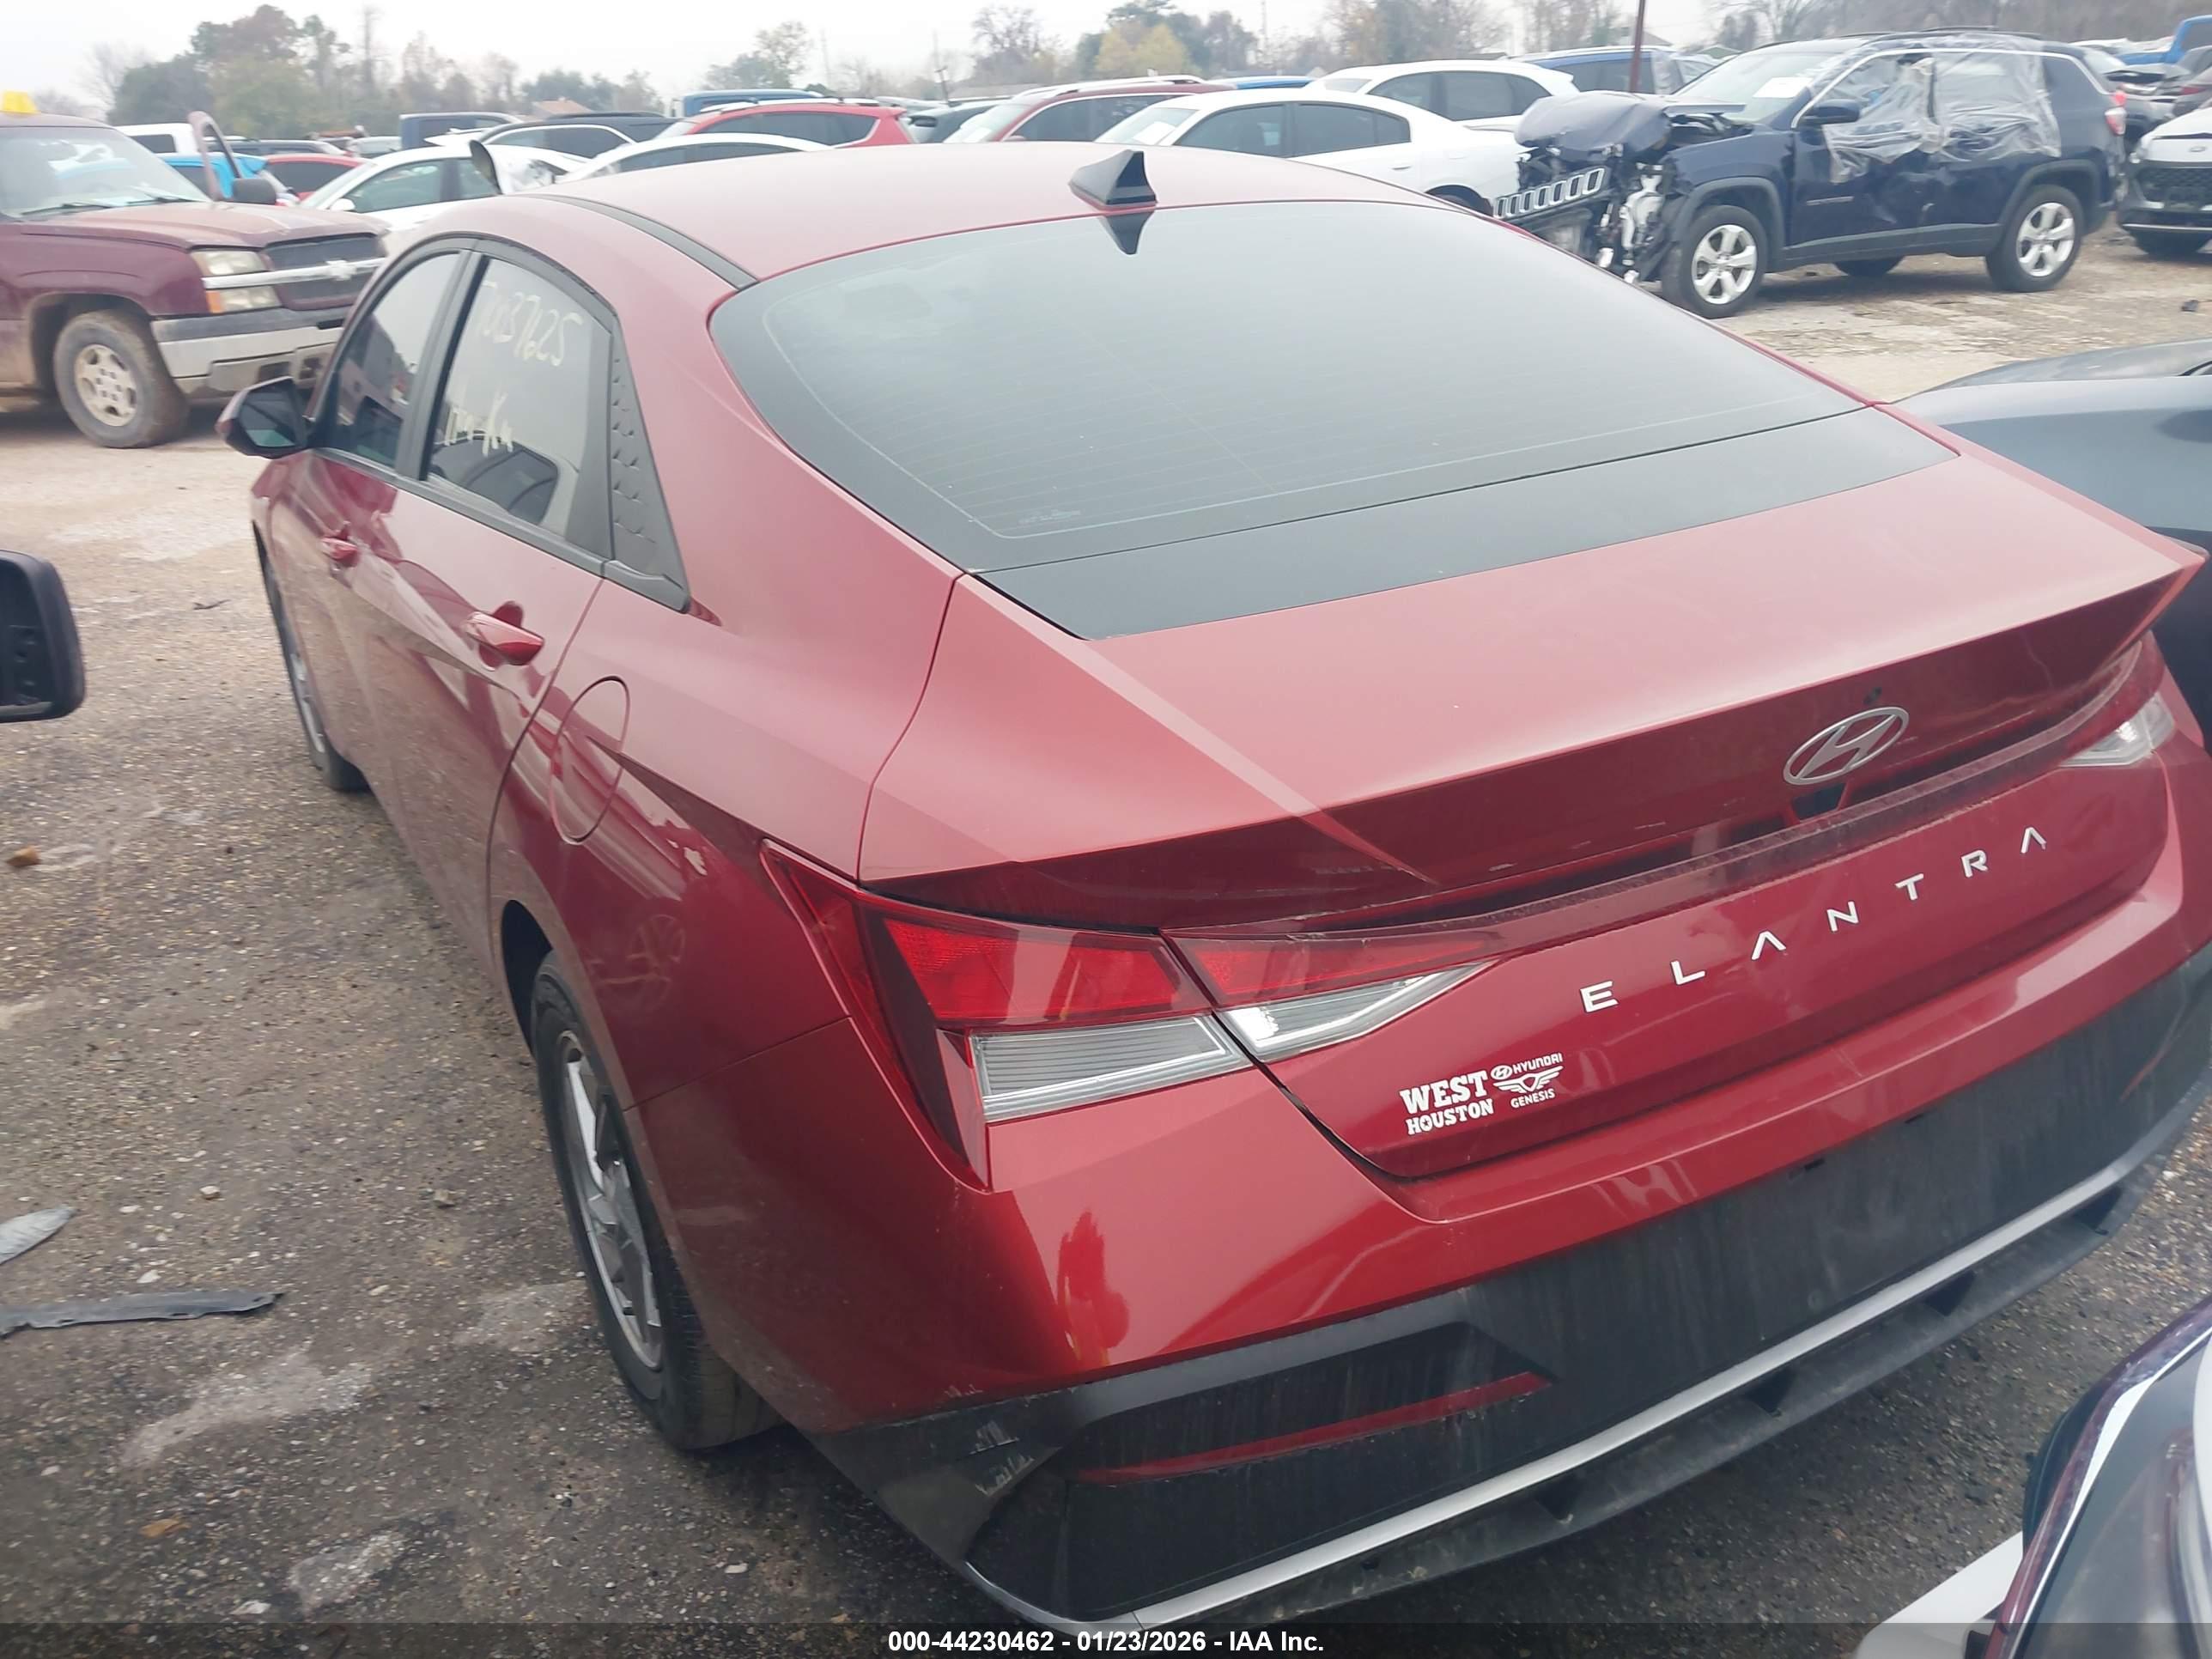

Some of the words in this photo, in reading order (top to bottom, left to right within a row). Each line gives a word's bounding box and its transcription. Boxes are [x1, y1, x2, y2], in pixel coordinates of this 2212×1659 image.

[1579, 826, 2047, 1013] ELANTRA
[1512, 1052, 1564, 1074] HYUNDAI
[1399, 1070, 1489, 1115] WEST
[1510, 1088, 1556, 1109] GENESIS
[1405, 1097, 1494, 1135] HOUSTON
